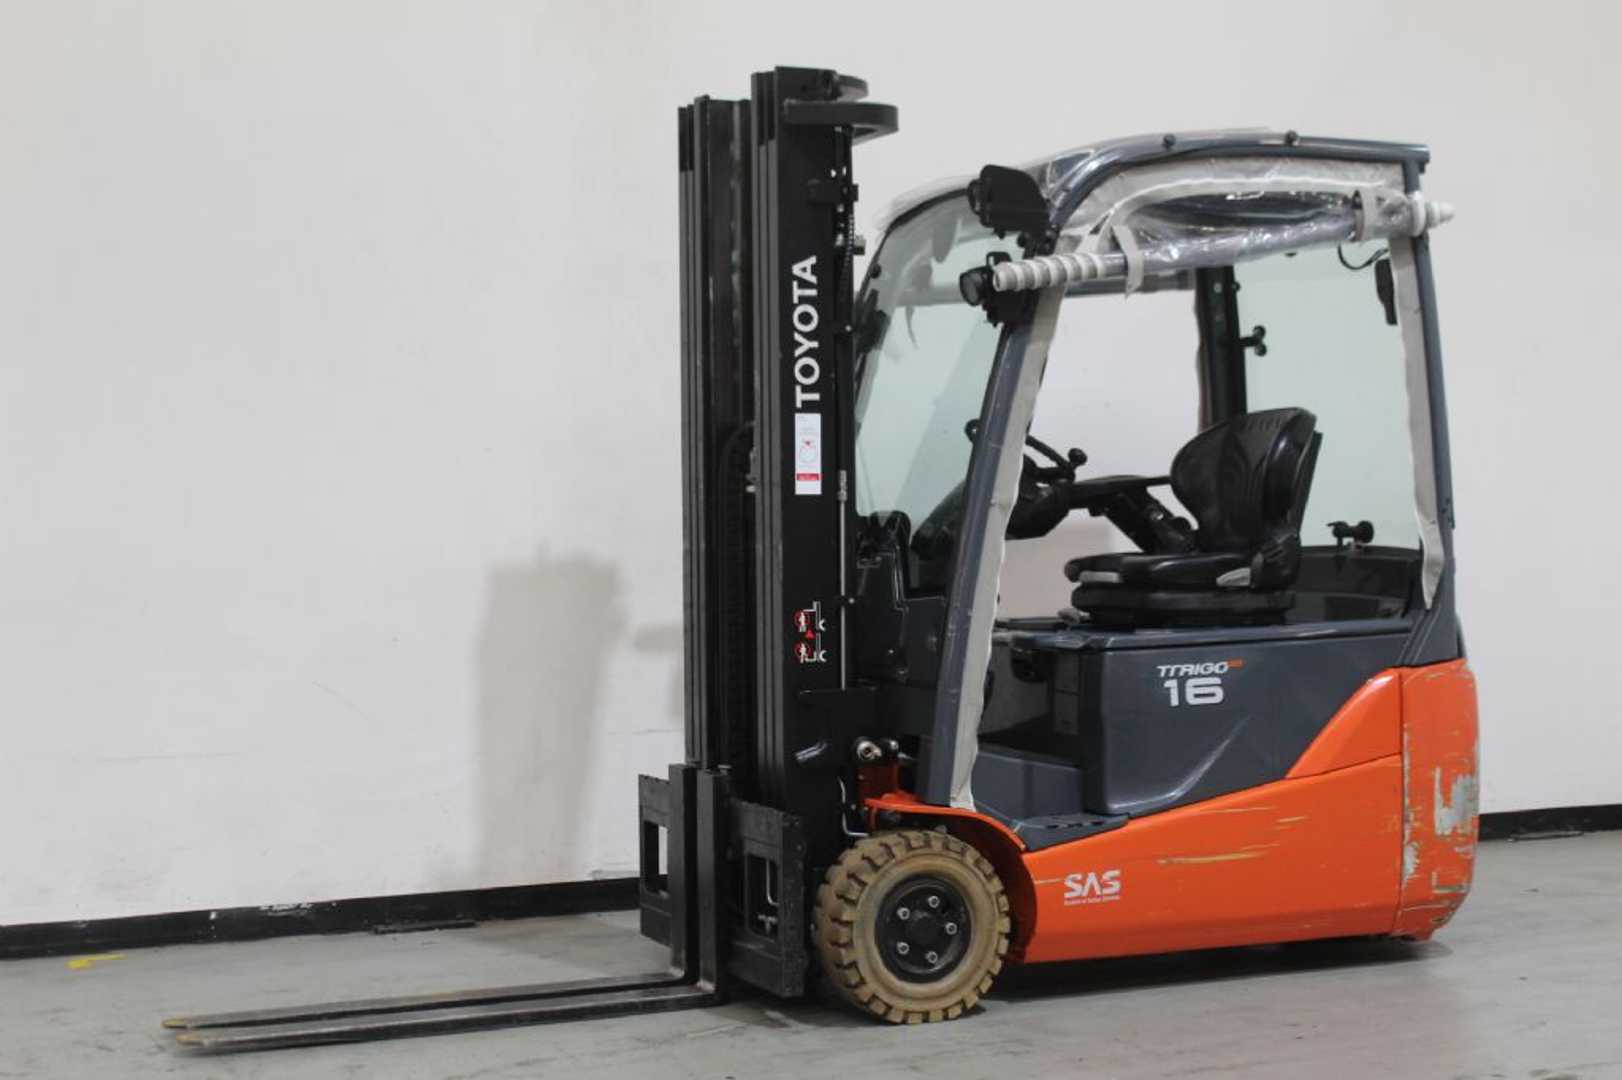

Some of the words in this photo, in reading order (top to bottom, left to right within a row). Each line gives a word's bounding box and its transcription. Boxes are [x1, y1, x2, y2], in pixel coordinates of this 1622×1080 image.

[792, 255, 820, 408] TOYOTA
[1163, 677, 1224, 707] 16
[1063, 870, 1121, 897] SAS
